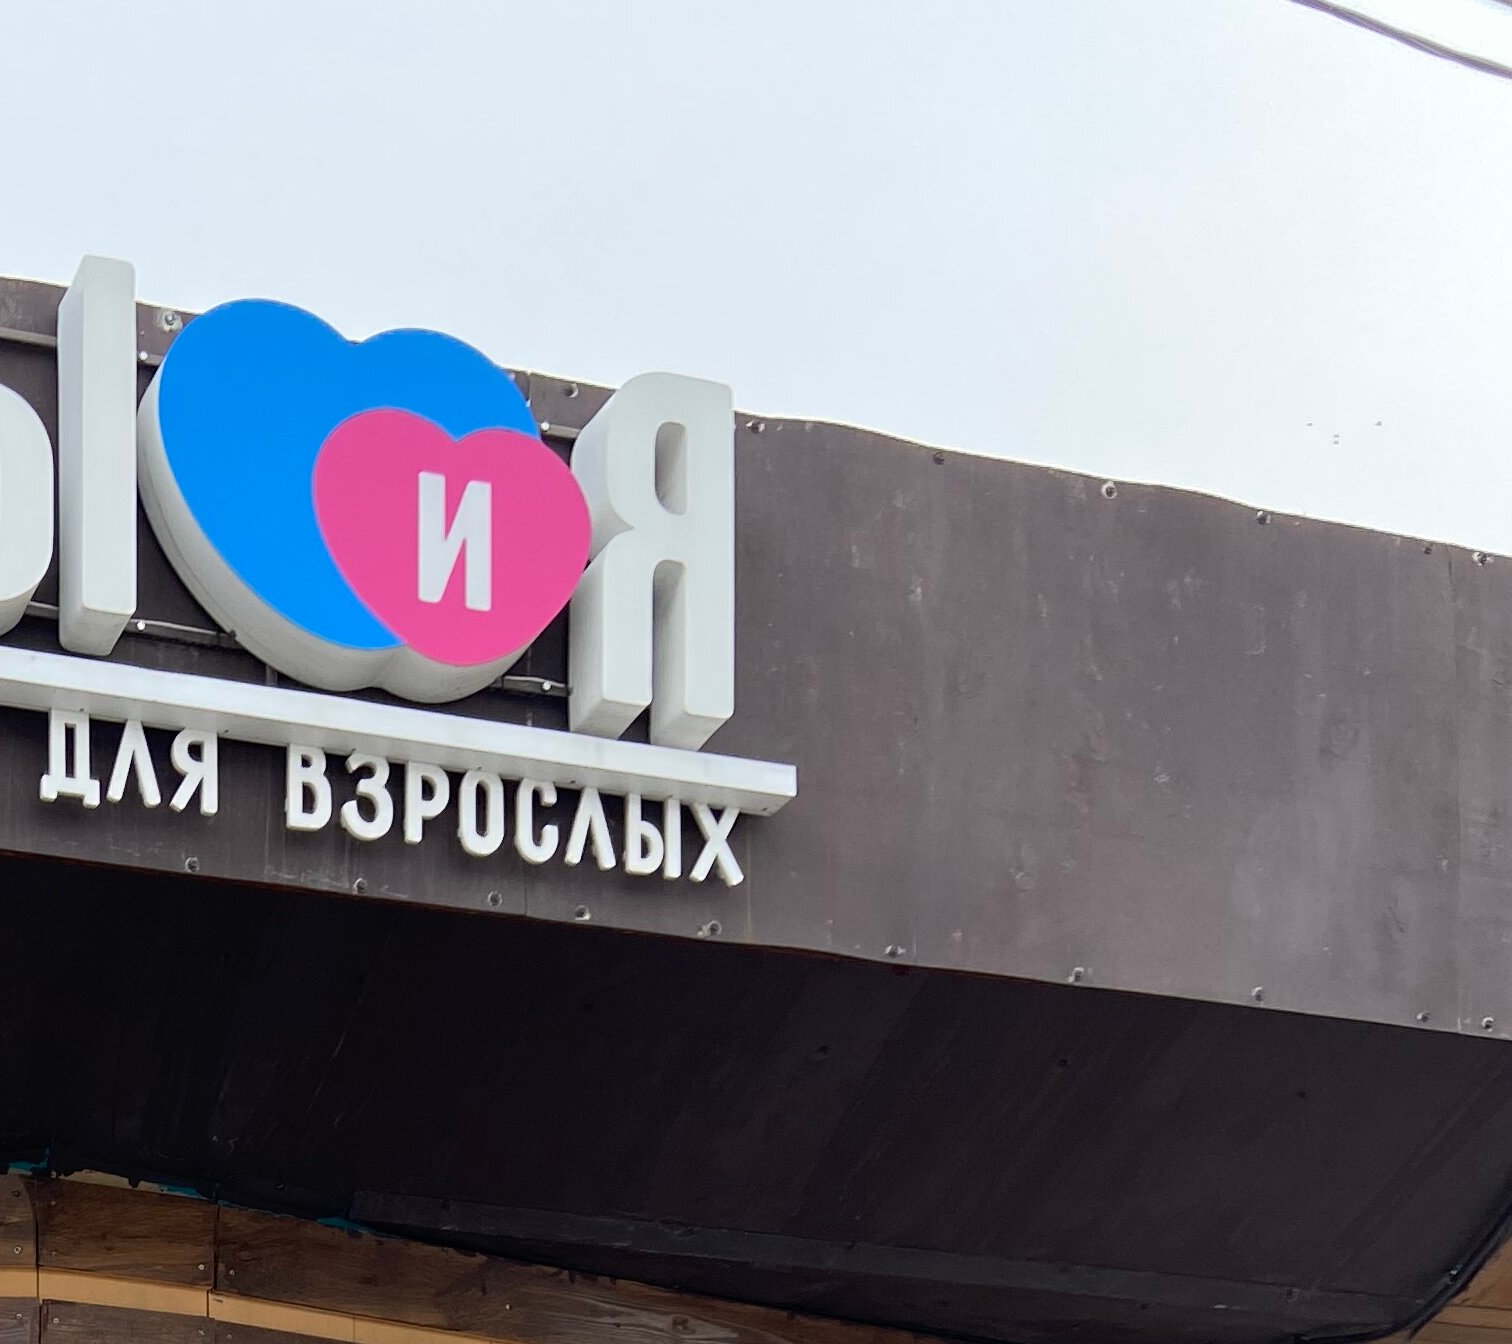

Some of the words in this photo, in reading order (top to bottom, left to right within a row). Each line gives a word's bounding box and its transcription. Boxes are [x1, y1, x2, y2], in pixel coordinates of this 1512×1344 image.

[569, 371, 735, 752] Я
[39, 709, 219, 816] ДЛЯ
[286, 743, 745, 887] ВЗРОСЛЫХ
